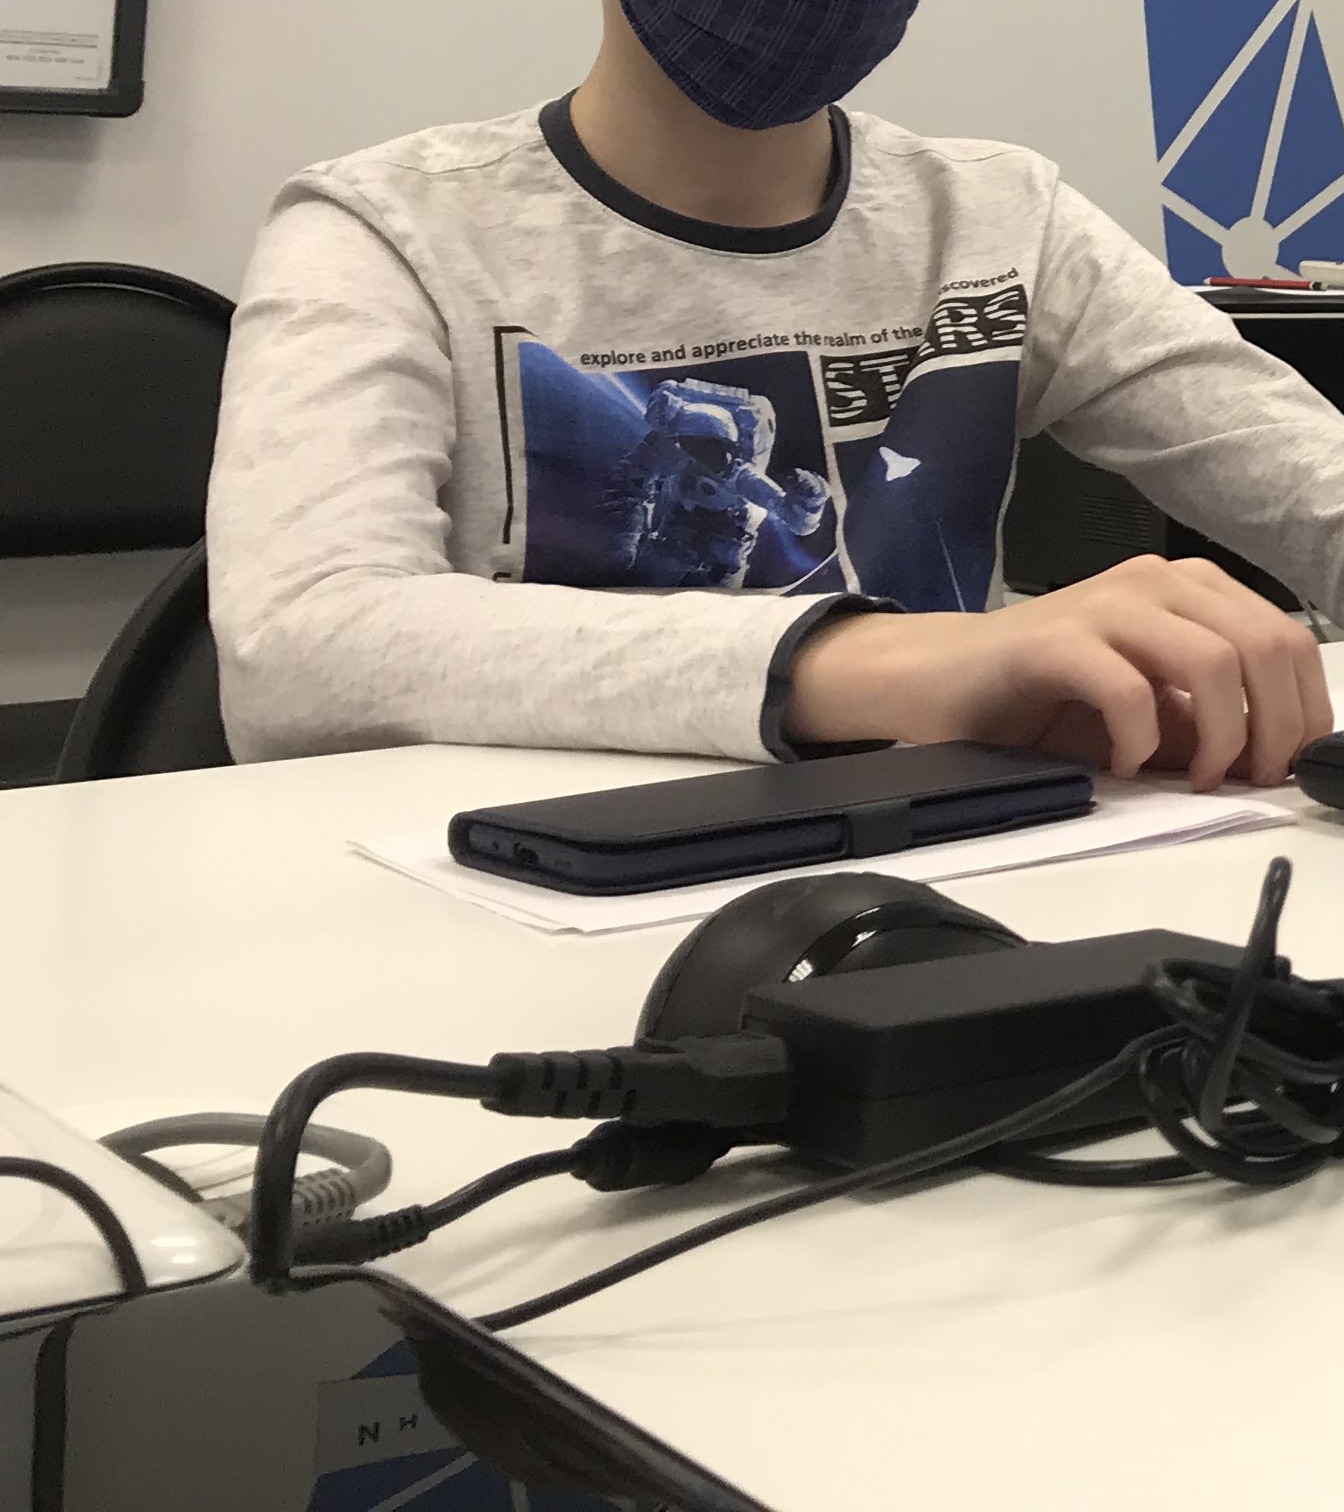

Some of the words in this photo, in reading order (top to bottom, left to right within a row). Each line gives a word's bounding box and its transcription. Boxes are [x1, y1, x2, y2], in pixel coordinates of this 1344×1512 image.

[580, 349, 646, 368] explore
[651, 344, 687, 362] and
[692, 332, 790, 358] appreciate
[793, 330, 822, 346] the
[870, 328, 889, 344] of
[891, 325, 924, 340] the
[938, 267, 1019, 294] scovered
[825, 289, 1027, 419] STRS
